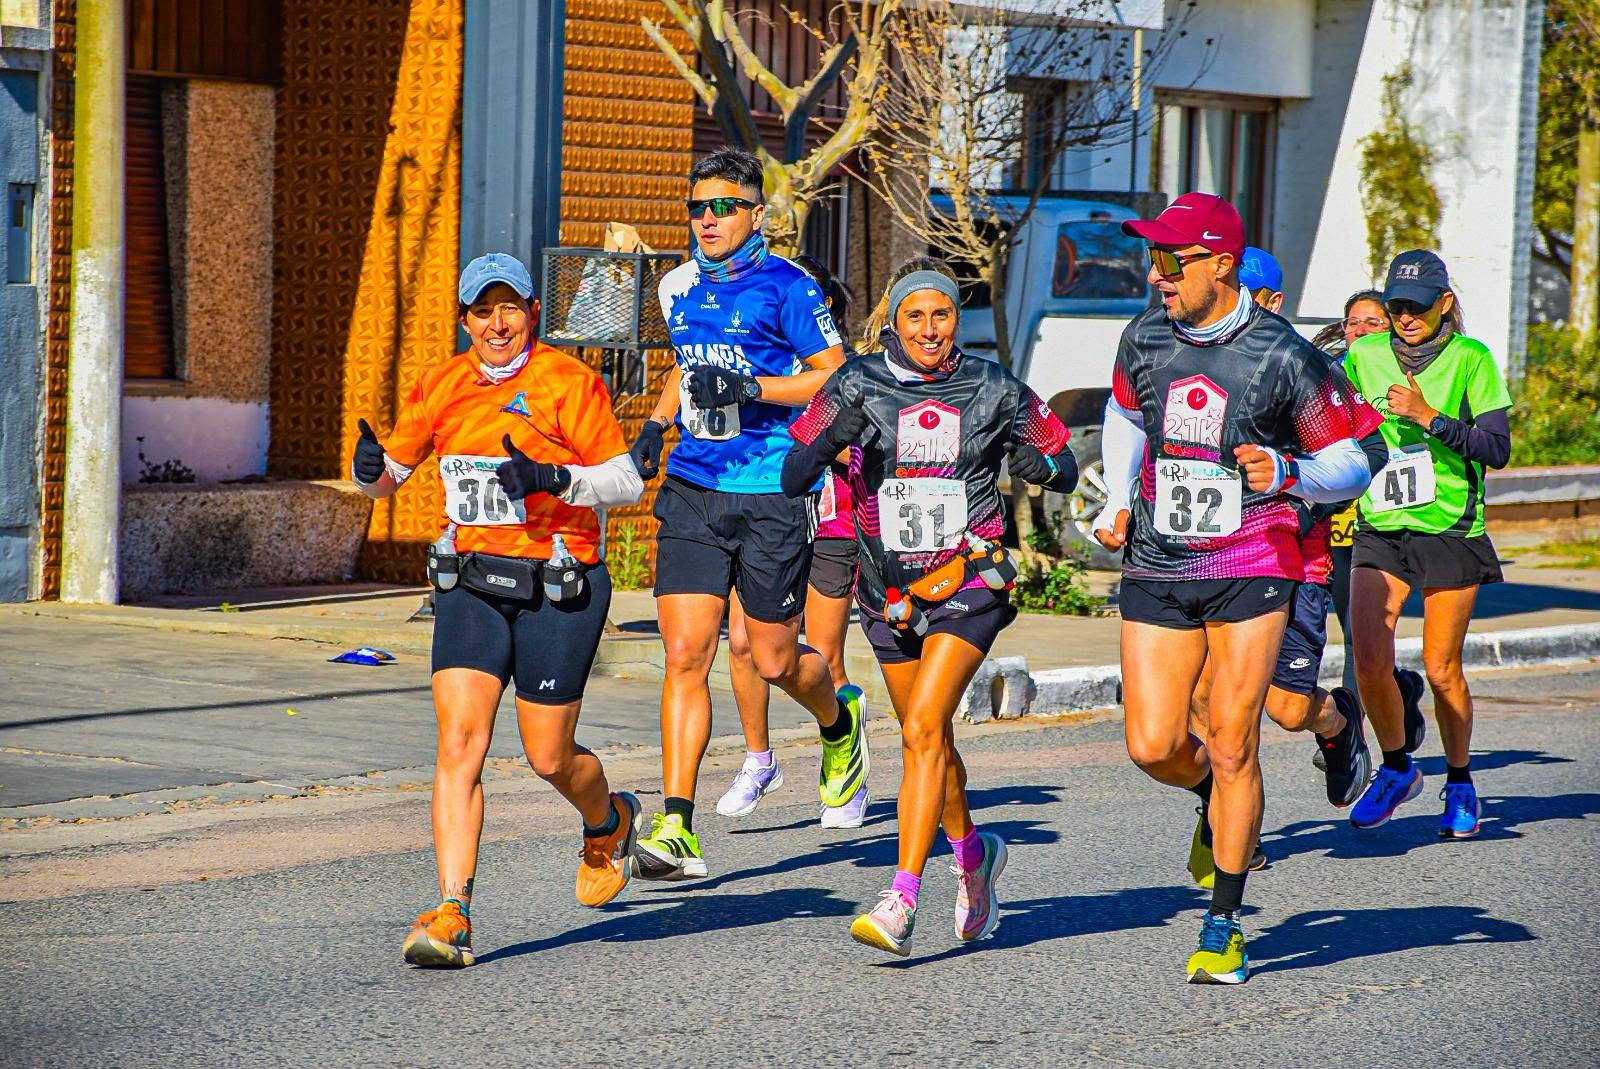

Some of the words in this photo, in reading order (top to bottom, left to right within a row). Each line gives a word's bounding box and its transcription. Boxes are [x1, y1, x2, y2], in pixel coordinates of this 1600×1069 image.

[899, 438, 958, 462] 21K
[1165, 413, 1222, 447] 21K
[457, 478, 508, 522] 30
[1384, 466, 1417, 505] 47
[899, 503, 945, 548] 31
[1169, 485, 1223, 532] 32
